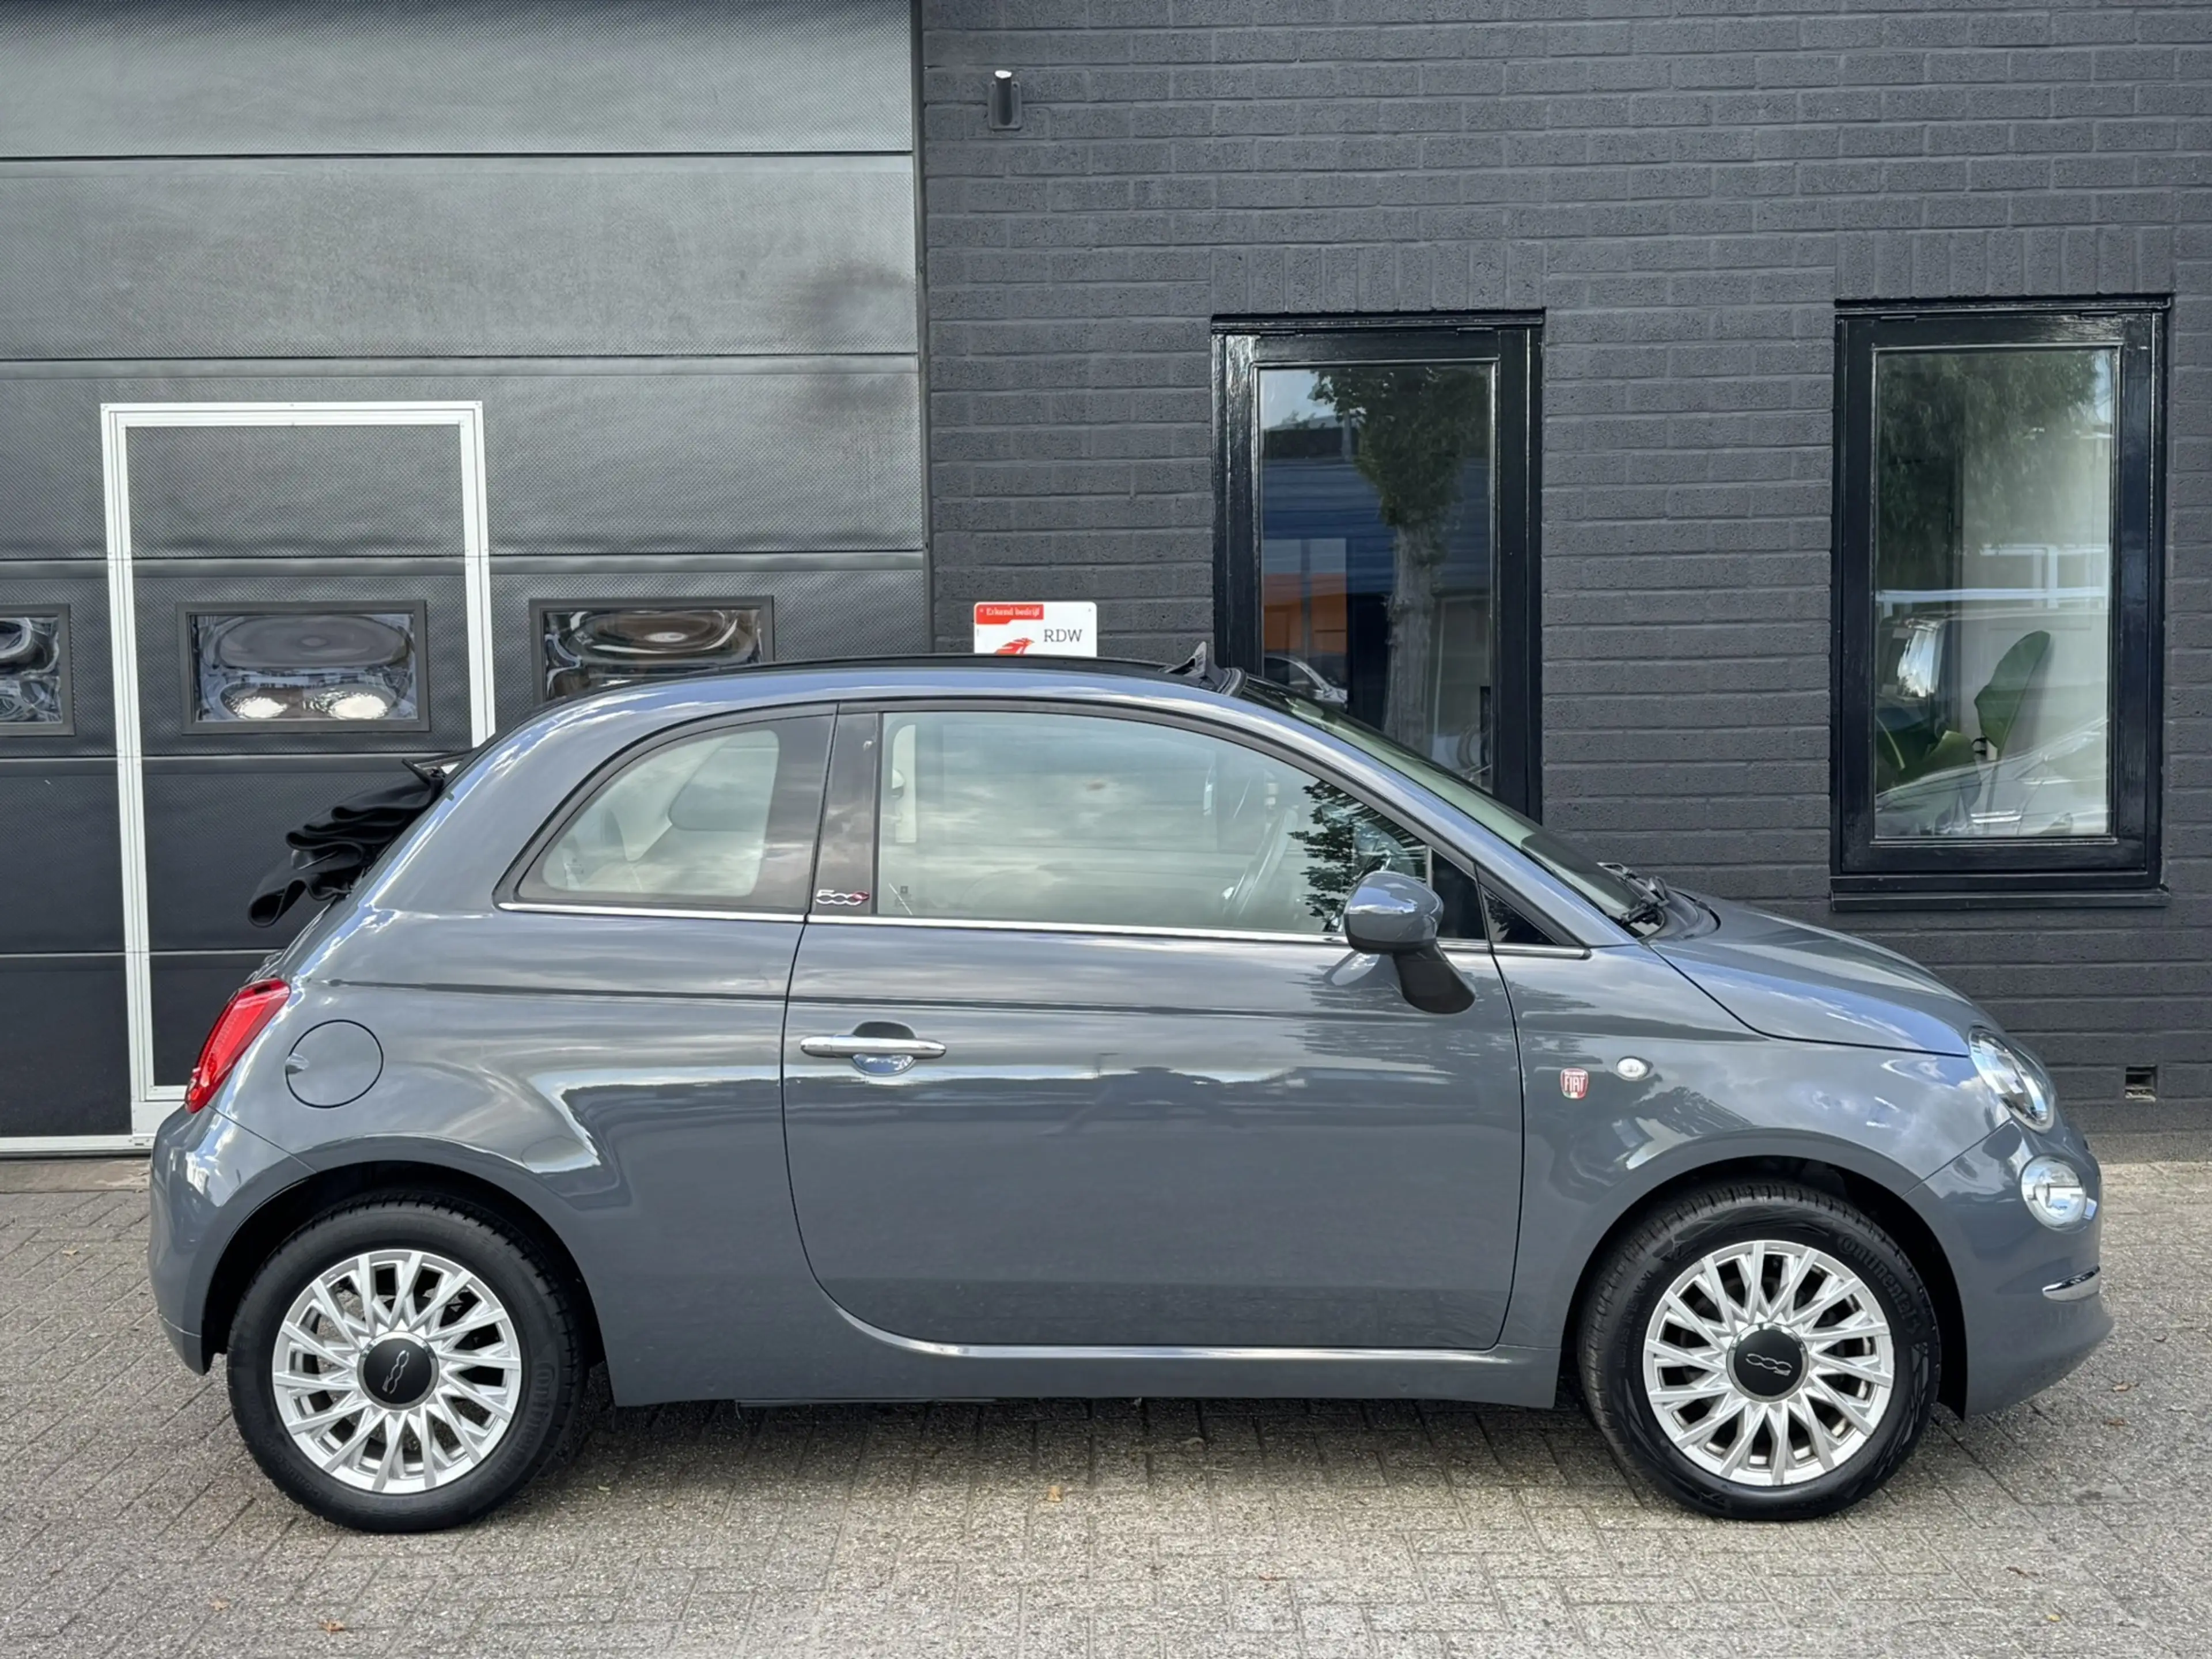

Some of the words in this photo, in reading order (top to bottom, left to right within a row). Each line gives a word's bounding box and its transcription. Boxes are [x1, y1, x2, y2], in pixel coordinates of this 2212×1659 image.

[986, 608, 1014, 616] Erkend
[1015, 607, 1040, 618] bedrijf
[1043, 628, 1083, 642] RDW
[1564, 1075, 1585, 1092] FIAT
